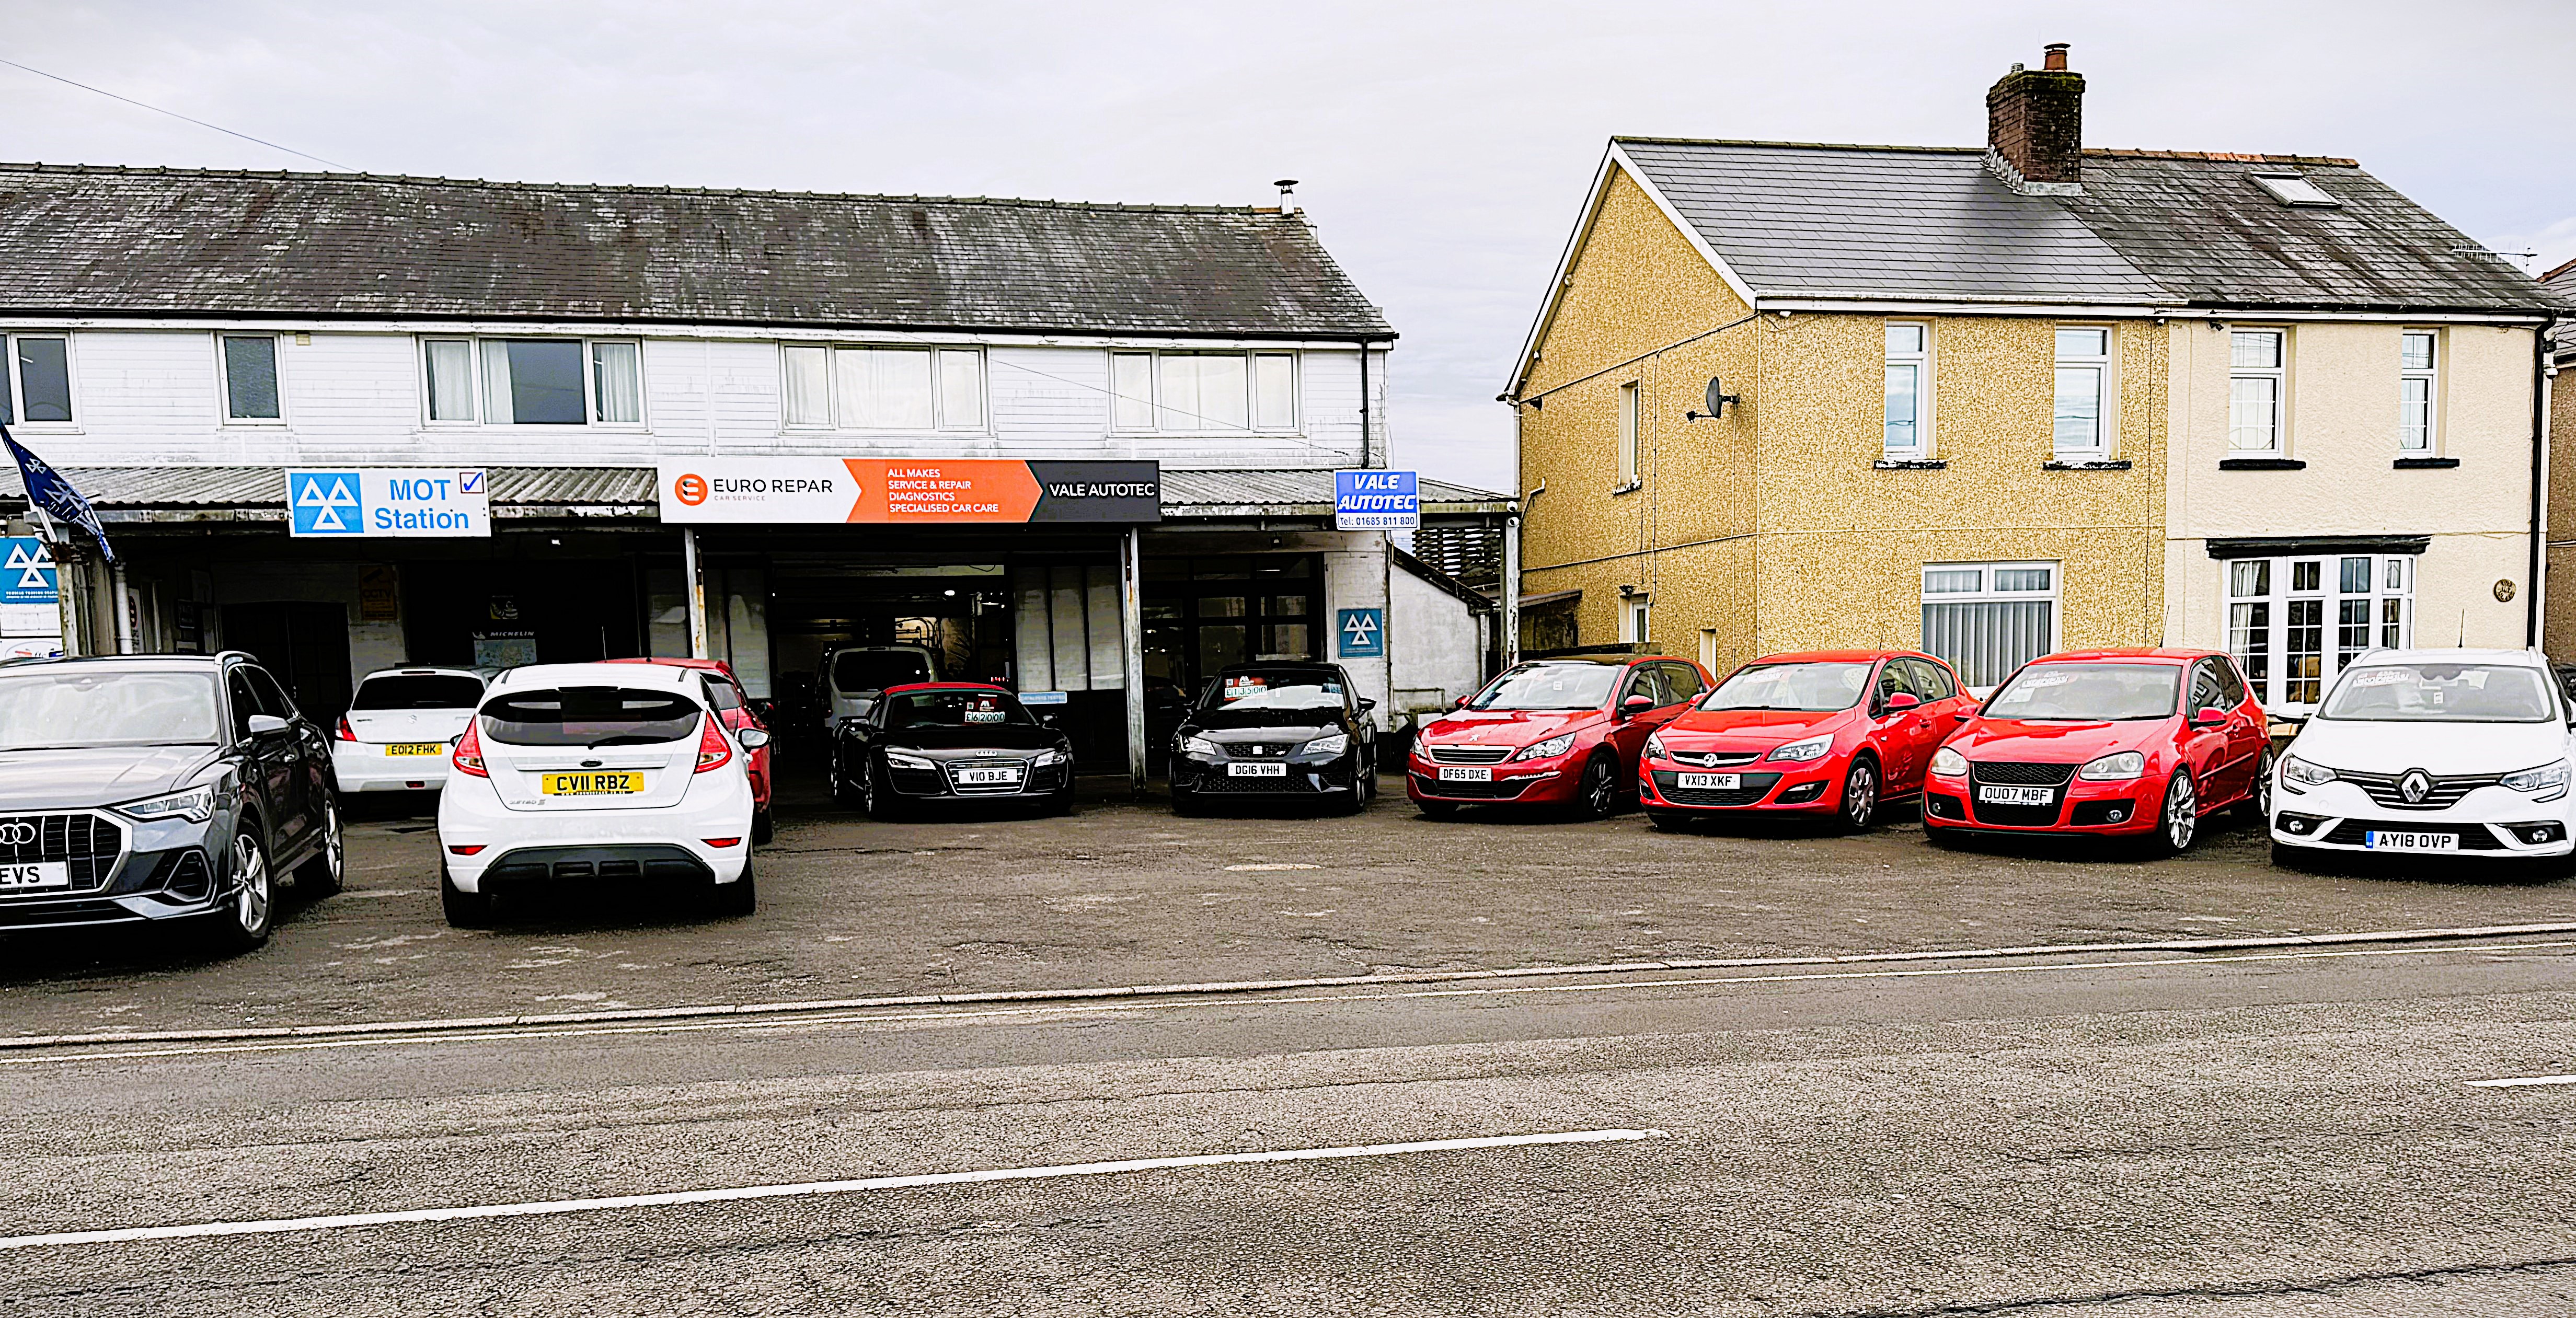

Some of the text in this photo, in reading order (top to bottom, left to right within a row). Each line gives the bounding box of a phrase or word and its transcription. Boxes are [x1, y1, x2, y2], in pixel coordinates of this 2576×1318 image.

[888, 468, 940, 478] ALL MAKES
[714, 479, 833, 493] EURO REPAR
[888, 480, 971, 489] SERVICE & REPAIR
[1355, 475, 1400, 490] VALE
[389, 479, 451, 500] MOT
[1049, 483, 1155, 496] VALE AUTOTEC
[889, 492, 955, 501] DIAGNOSTICS
[1338, 495, 1416, 510] AUTOTEC
[889, 503, 999, 513] SPECIALISED CAR CARE
[375, 507, 468, 529] Station
[1340, 517, 1354, 525] Tel:
[1356, 517, 1380, 525] 01685
[362, 588, 392, 598] CCTV
[1226, 686, 1266, 696] £13500
[966, 713, 1004, 722] £62000
[392, 745, 436, 755] EO12 FHK
[1235, 765, 1280, 774] DG16 VHH
[1444, 769, 1487, 779] DF65 DXE
[970, 771, 1007, 781] V10 BJE
[1685, 774, 1732, 786] VX13 XKF
[557, 775, 629, 790] CV11 RBZ
[1985, 788, 2048, 801] OU07 MBF
[2379, 834, 2451, 848] AY18 OVP
[0, 866, 40, 885] EVS
